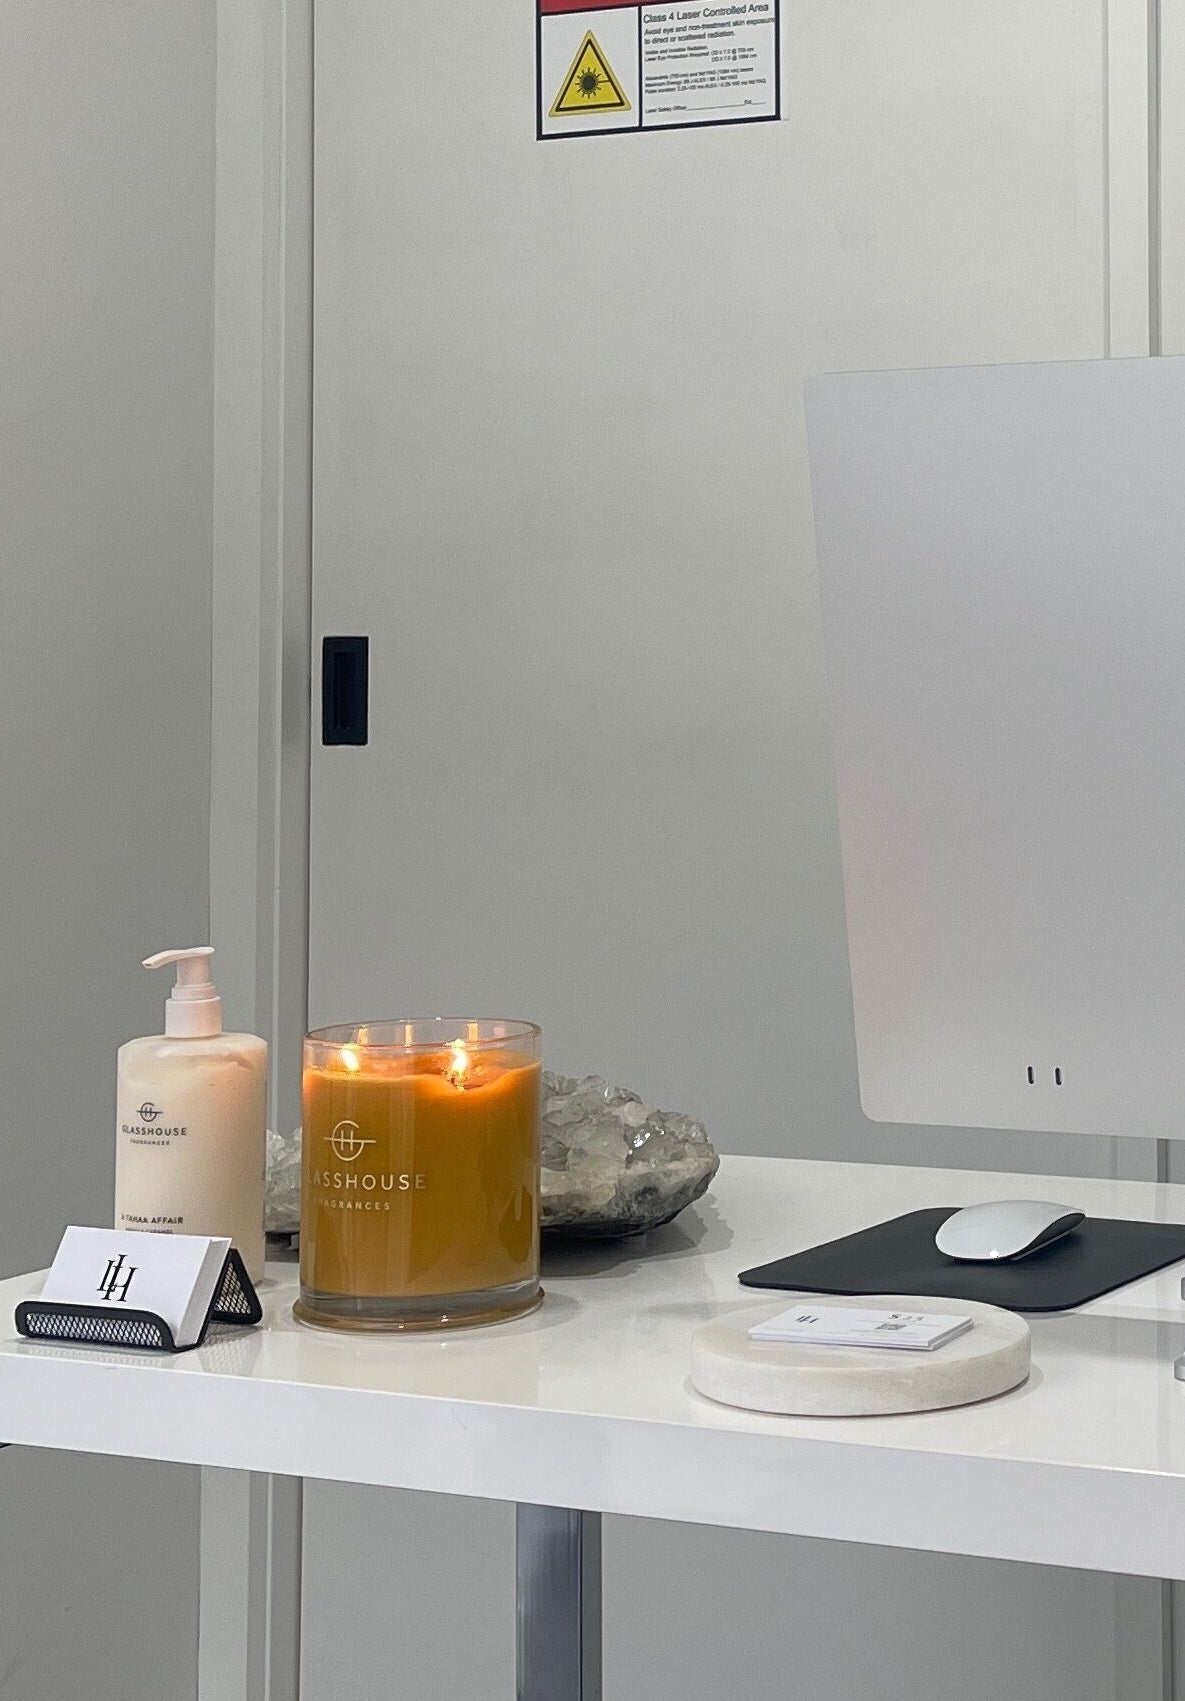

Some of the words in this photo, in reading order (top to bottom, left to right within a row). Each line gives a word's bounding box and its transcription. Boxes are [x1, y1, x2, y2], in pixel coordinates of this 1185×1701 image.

[643, 14, 667, 23] Class
[669, 12, 675, 20] 4
[677, 10, 701, 20] Laser
[703, 5, 747, 17] Controlled
[748, 4, 770, 13] Area
[663, 27, 674, 35] eye
[675, 25, 687, 33] and
[122, 1125, 187, 1136] GLASSHOUSE
[151, 1216, 184, 1224] AFFAIR
